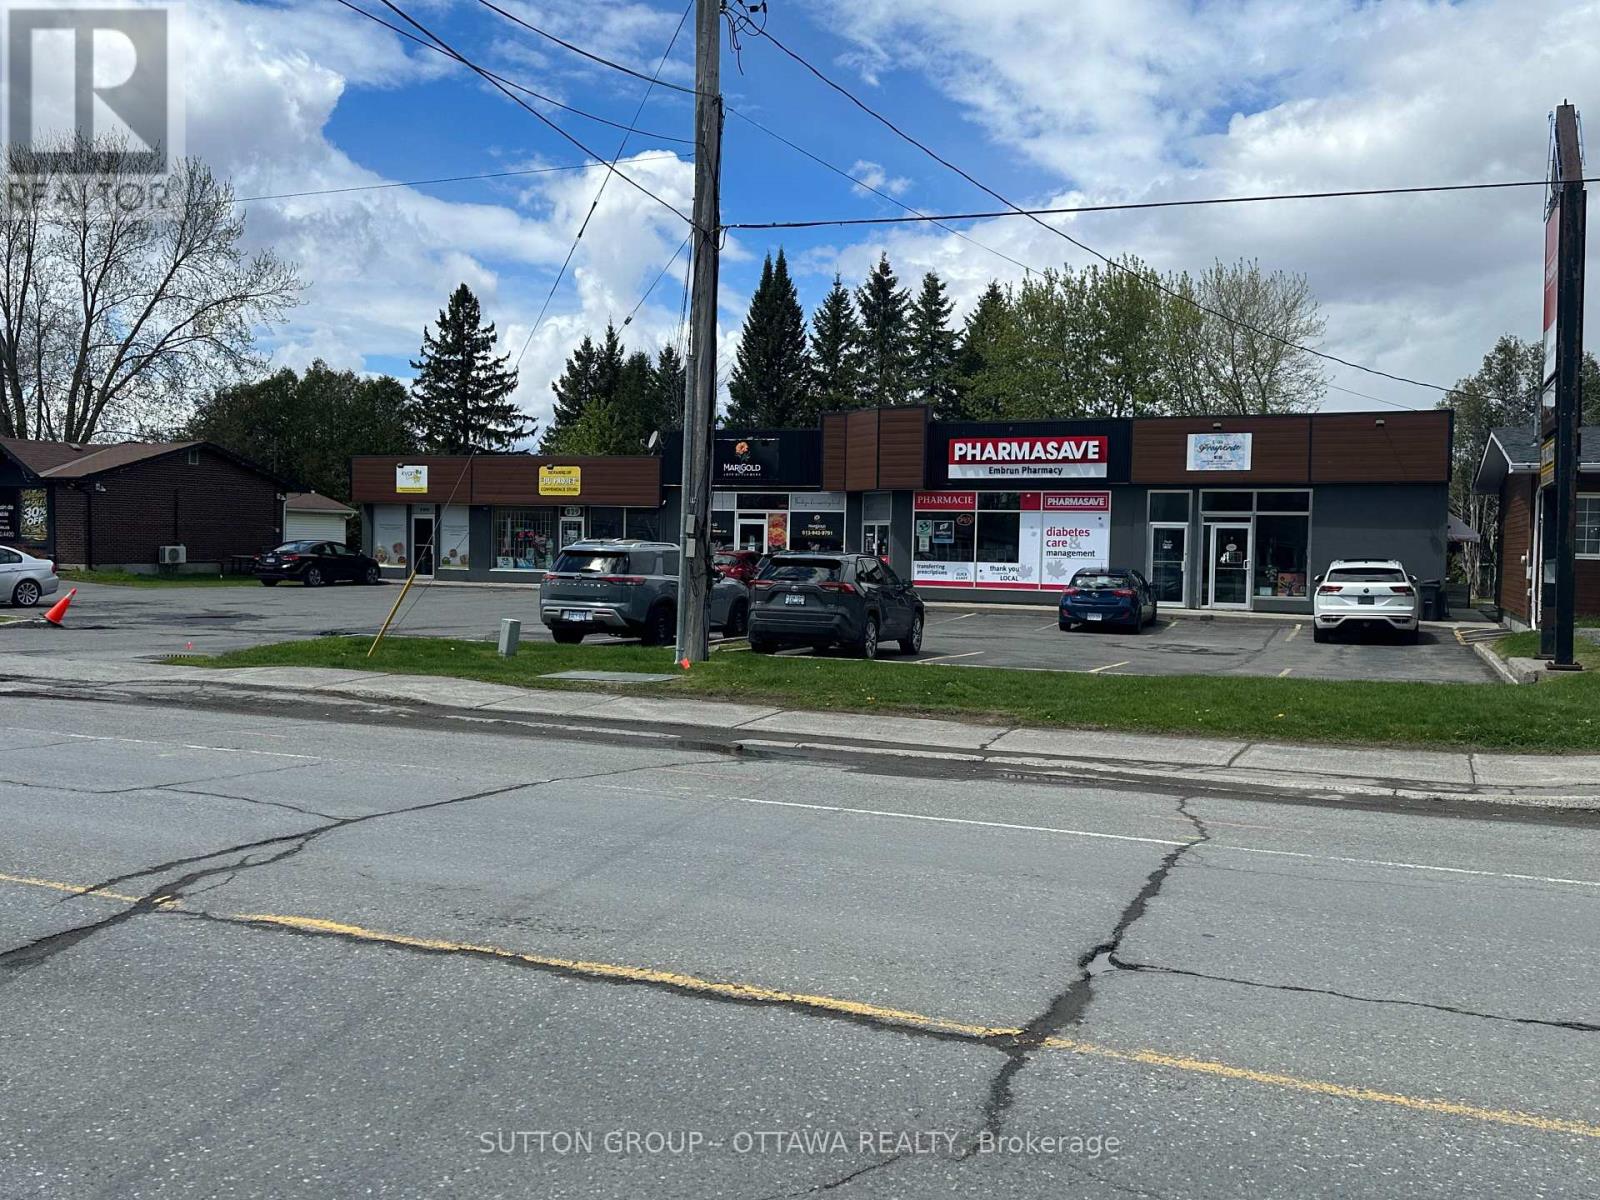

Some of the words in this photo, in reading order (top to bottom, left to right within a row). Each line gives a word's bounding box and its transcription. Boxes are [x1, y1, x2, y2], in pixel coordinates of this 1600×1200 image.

[954, 441, 1100, 461] PHARMASAVE
[989, 466, 1020, 475] Embrun
[1021, 466, 1063, 476] Pharmacy
[917, 494, 974, 505] PHARMACIE
[1046, 497, 1105, 506] PHARMASAVE
[23, 506, 48, 519] 30%
[26, 516, 44, 526] OFF
[1046, 526, 1090, 537] diabetes
[1046, 538, 1068, 548] care
[1046, 549, 1096, 558] management
